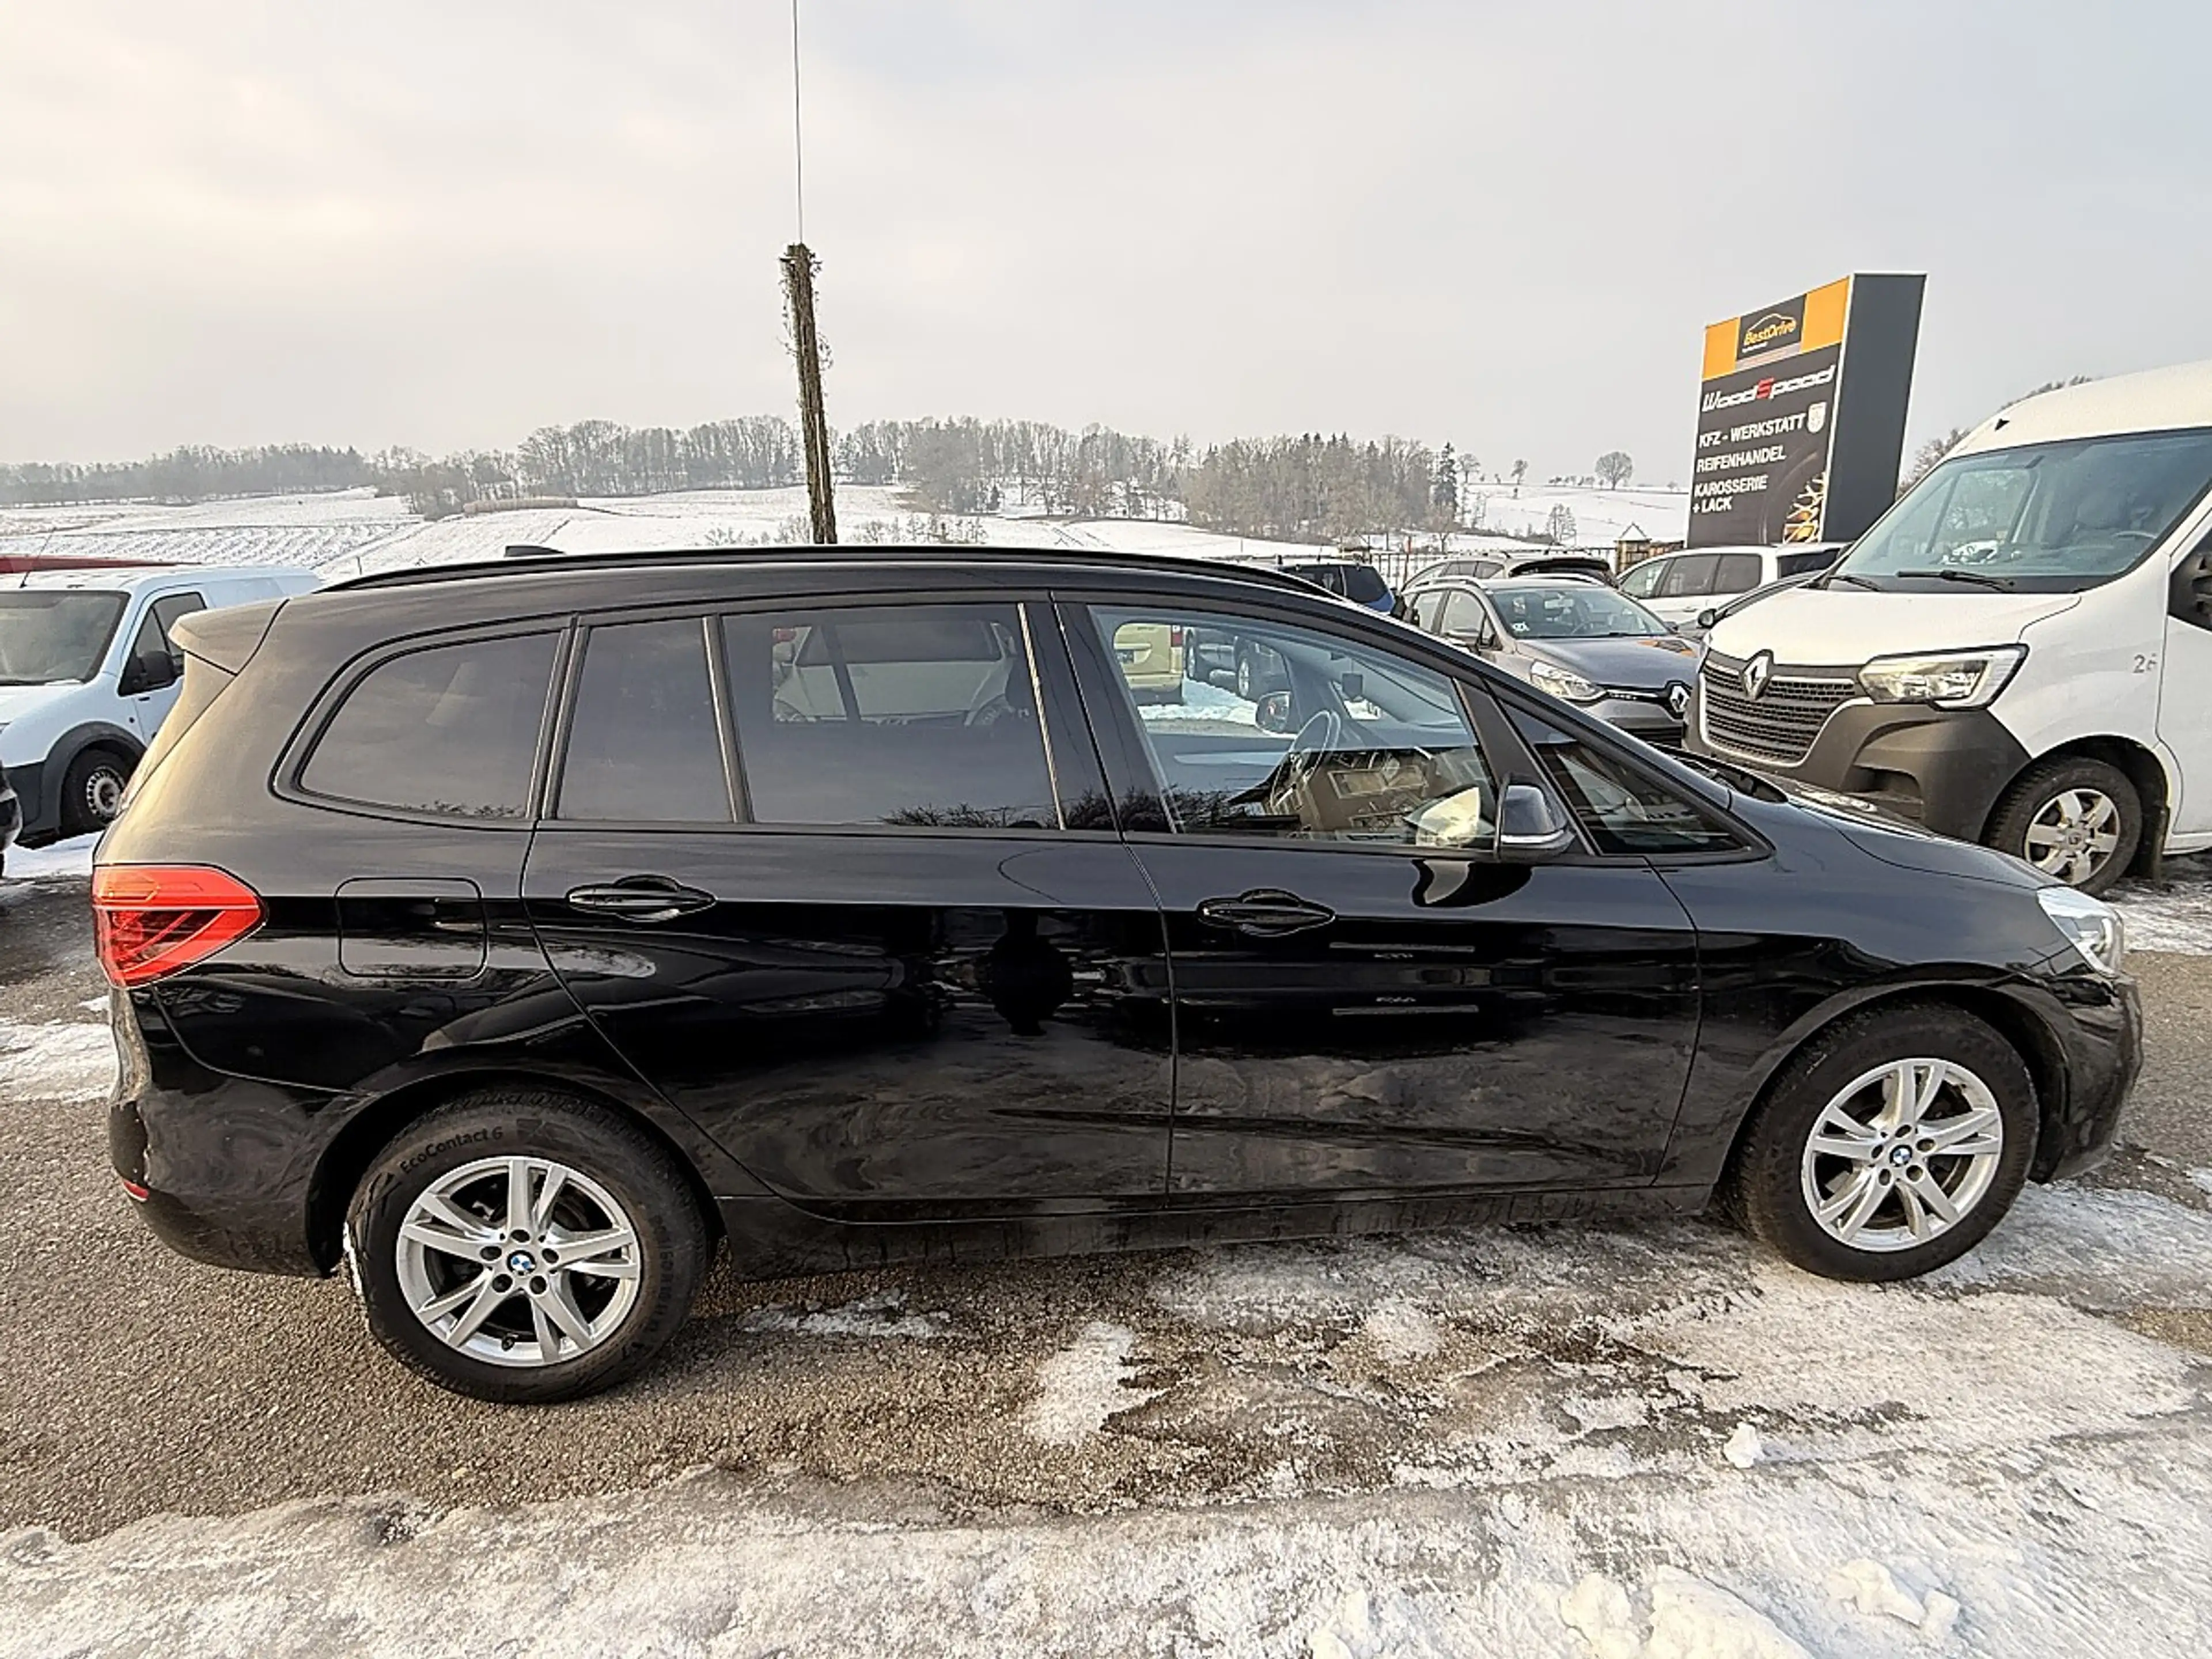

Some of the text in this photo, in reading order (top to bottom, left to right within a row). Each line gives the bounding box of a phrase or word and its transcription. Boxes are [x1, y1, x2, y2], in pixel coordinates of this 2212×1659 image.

[1699, 431, 1722, 448] KFZ
[1730, 413, 1806, 442] WERKSTATT
[1696, 445, 1786, 473] REIFENHANDEL
[1694, 474, 1768, 498] KAROSSERIE
[1701, 496, 1733, 513] LACK
[400, 1126, 503, 1174] EcoContact 6
